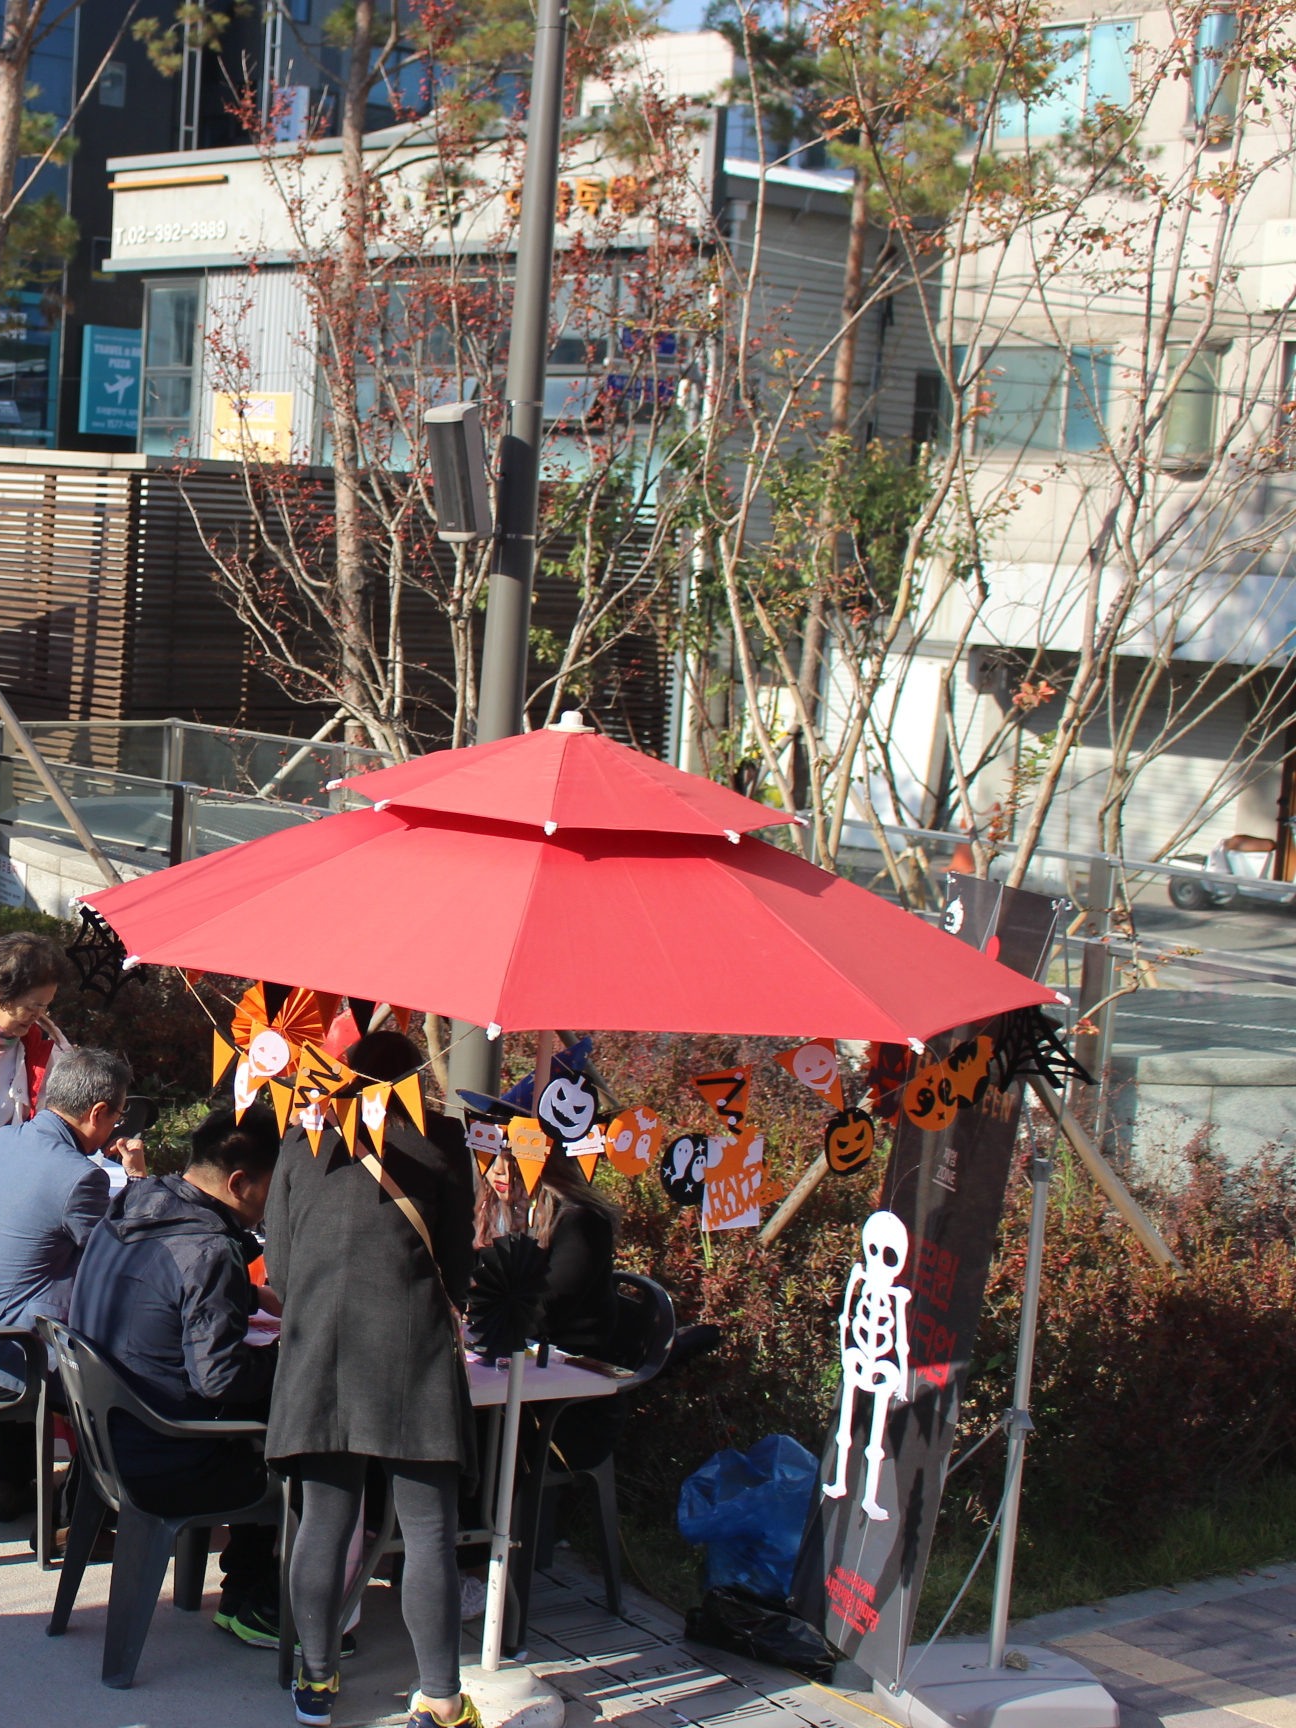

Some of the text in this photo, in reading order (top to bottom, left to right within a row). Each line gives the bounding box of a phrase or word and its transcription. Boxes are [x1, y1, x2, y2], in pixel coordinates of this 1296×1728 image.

[114, 219, 228, 246] T.02-392-3989
[706, 1158, 772, 1213] HAPPY
[936, 1164, 957, 1185] ZONE
